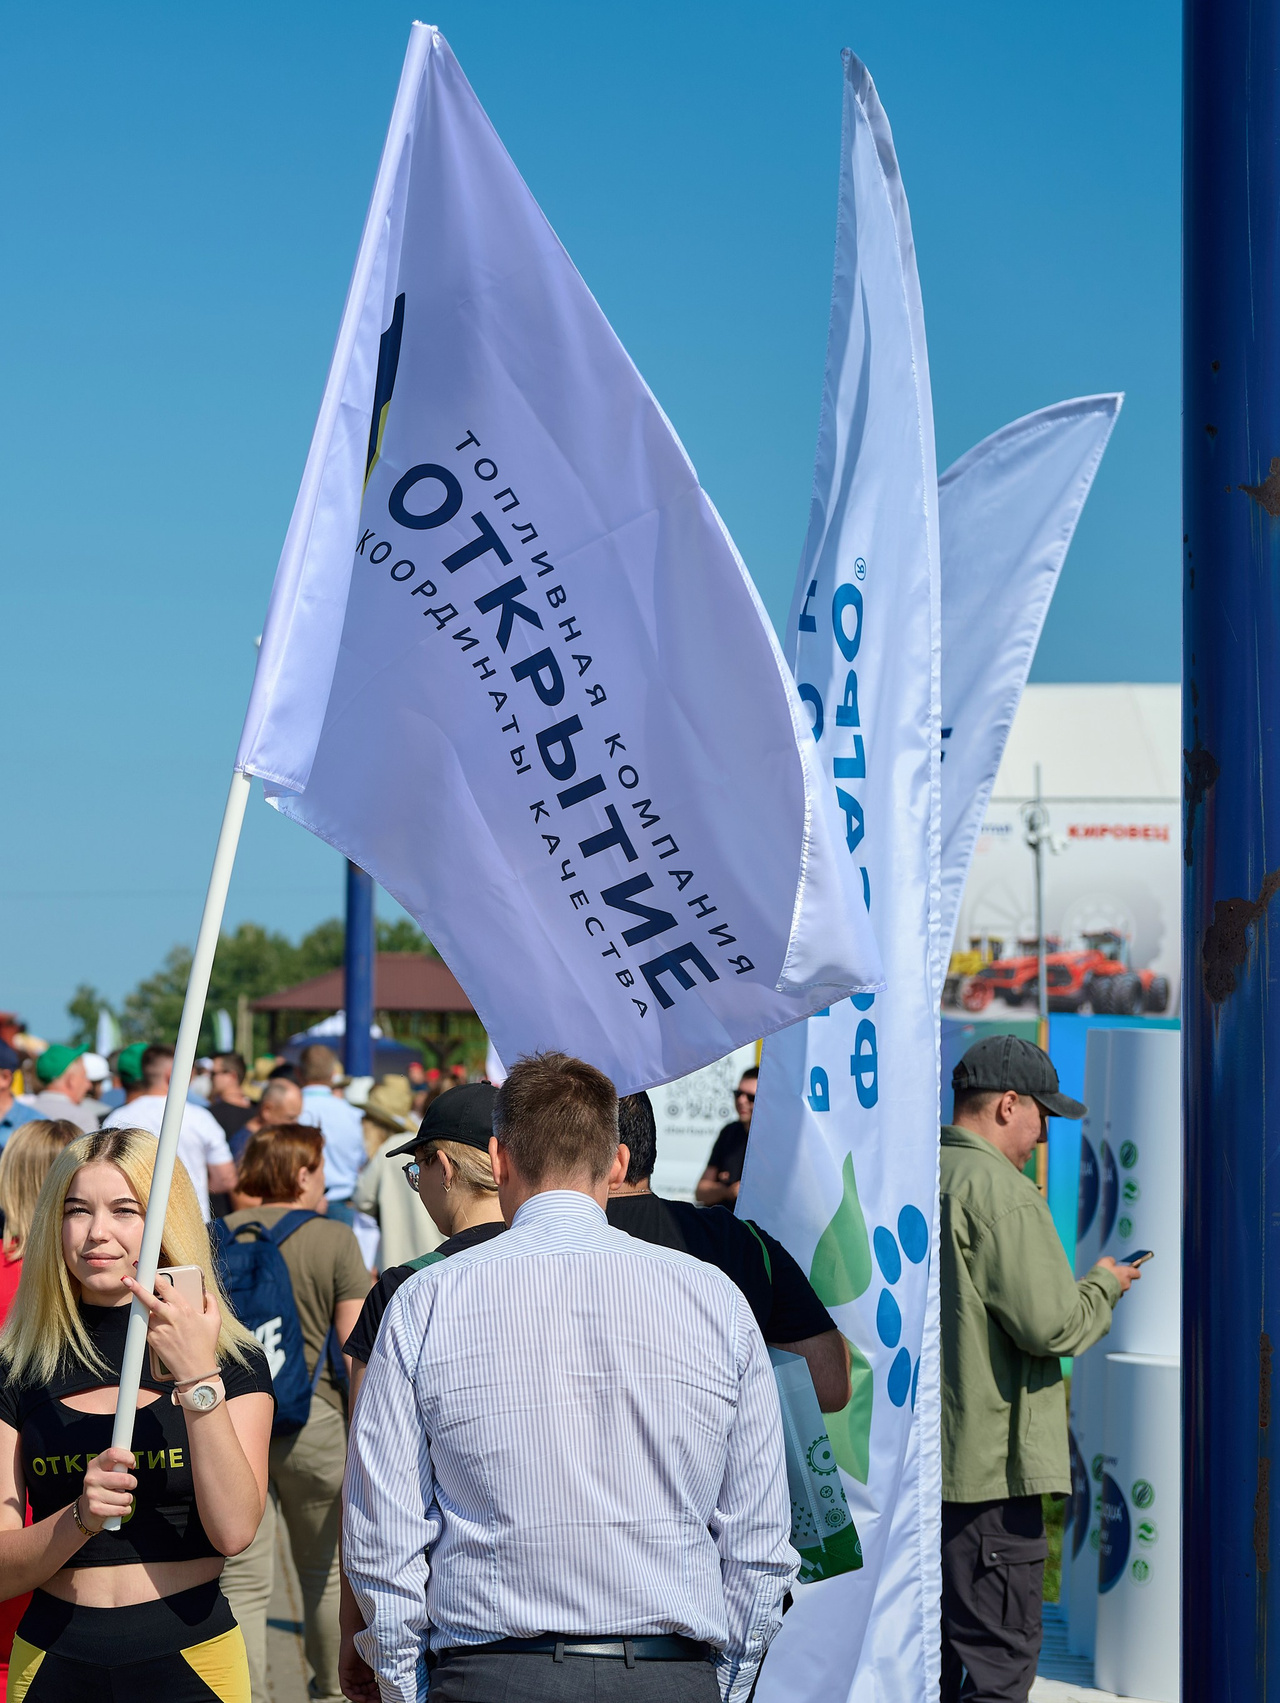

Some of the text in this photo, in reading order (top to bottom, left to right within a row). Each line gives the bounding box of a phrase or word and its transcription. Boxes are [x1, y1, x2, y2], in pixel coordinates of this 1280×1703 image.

[356, 528, 648, 1018] КООРДИНАТЫ КАЧЕСТВА
[388, 463, 720, 1010] ОТКРЫТИЕ
[454, 430, 755, 975] ТОПЛИВНАЯ КОМПАНИЯ
[1067, 823, 1170, 842] КИРОВЕЦ
[32, 1448, 184, 1476] ОТКТИЕ
